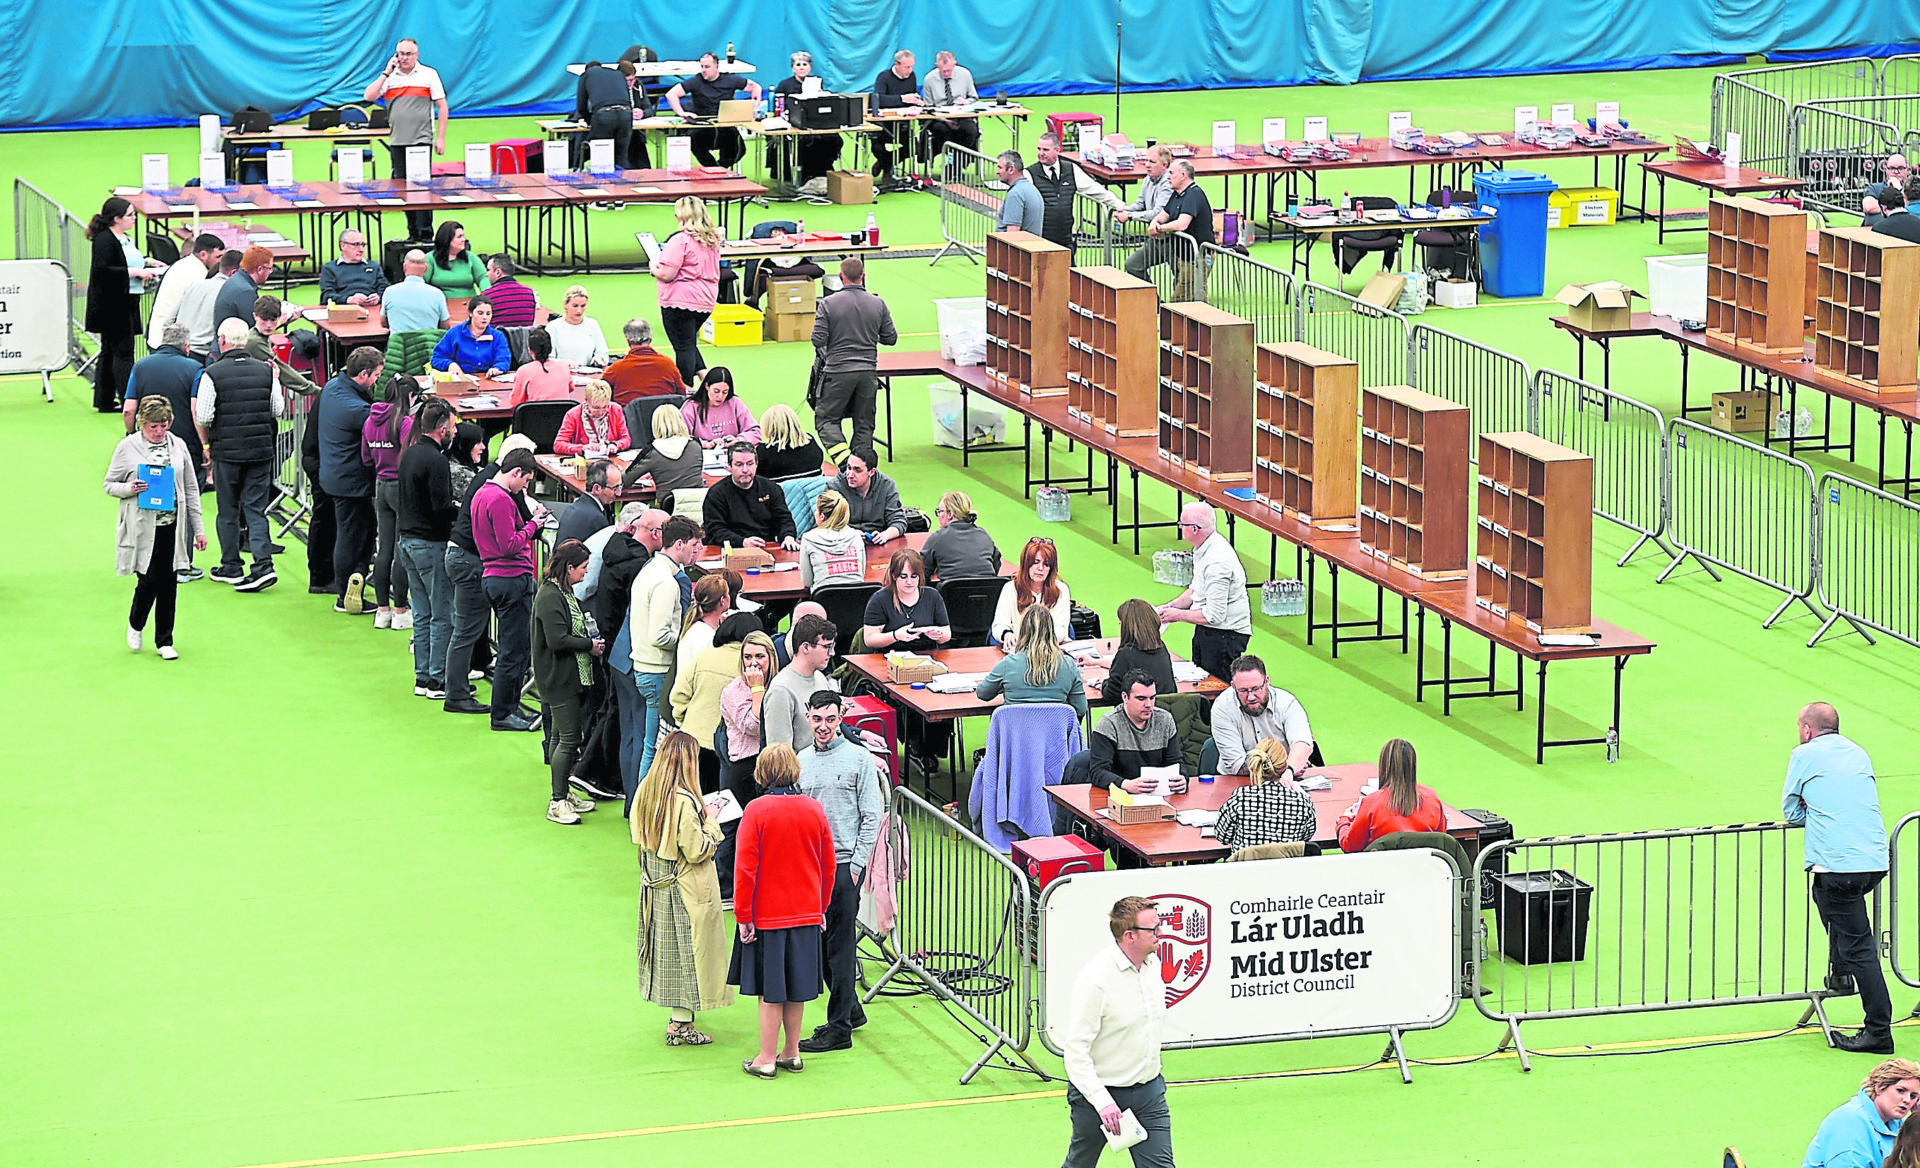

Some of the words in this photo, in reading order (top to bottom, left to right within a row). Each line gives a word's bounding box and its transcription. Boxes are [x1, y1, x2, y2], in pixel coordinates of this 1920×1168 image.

[832, 561, 857, 573] KLEIN
[1230, 895, 1314, 915] Comhairle
[1318, 889, 1386, 909] Ceantair
[1230, 915, 1278, 944] Lár
[1282, 910, 1365, 940] Uladh
[1230, 951, 1285, 980] Mid
[1289, 948, 1373, 974] Ulster
[1230, 980, 1290, 999] District
[1293, 974, 1355, 993] Council
